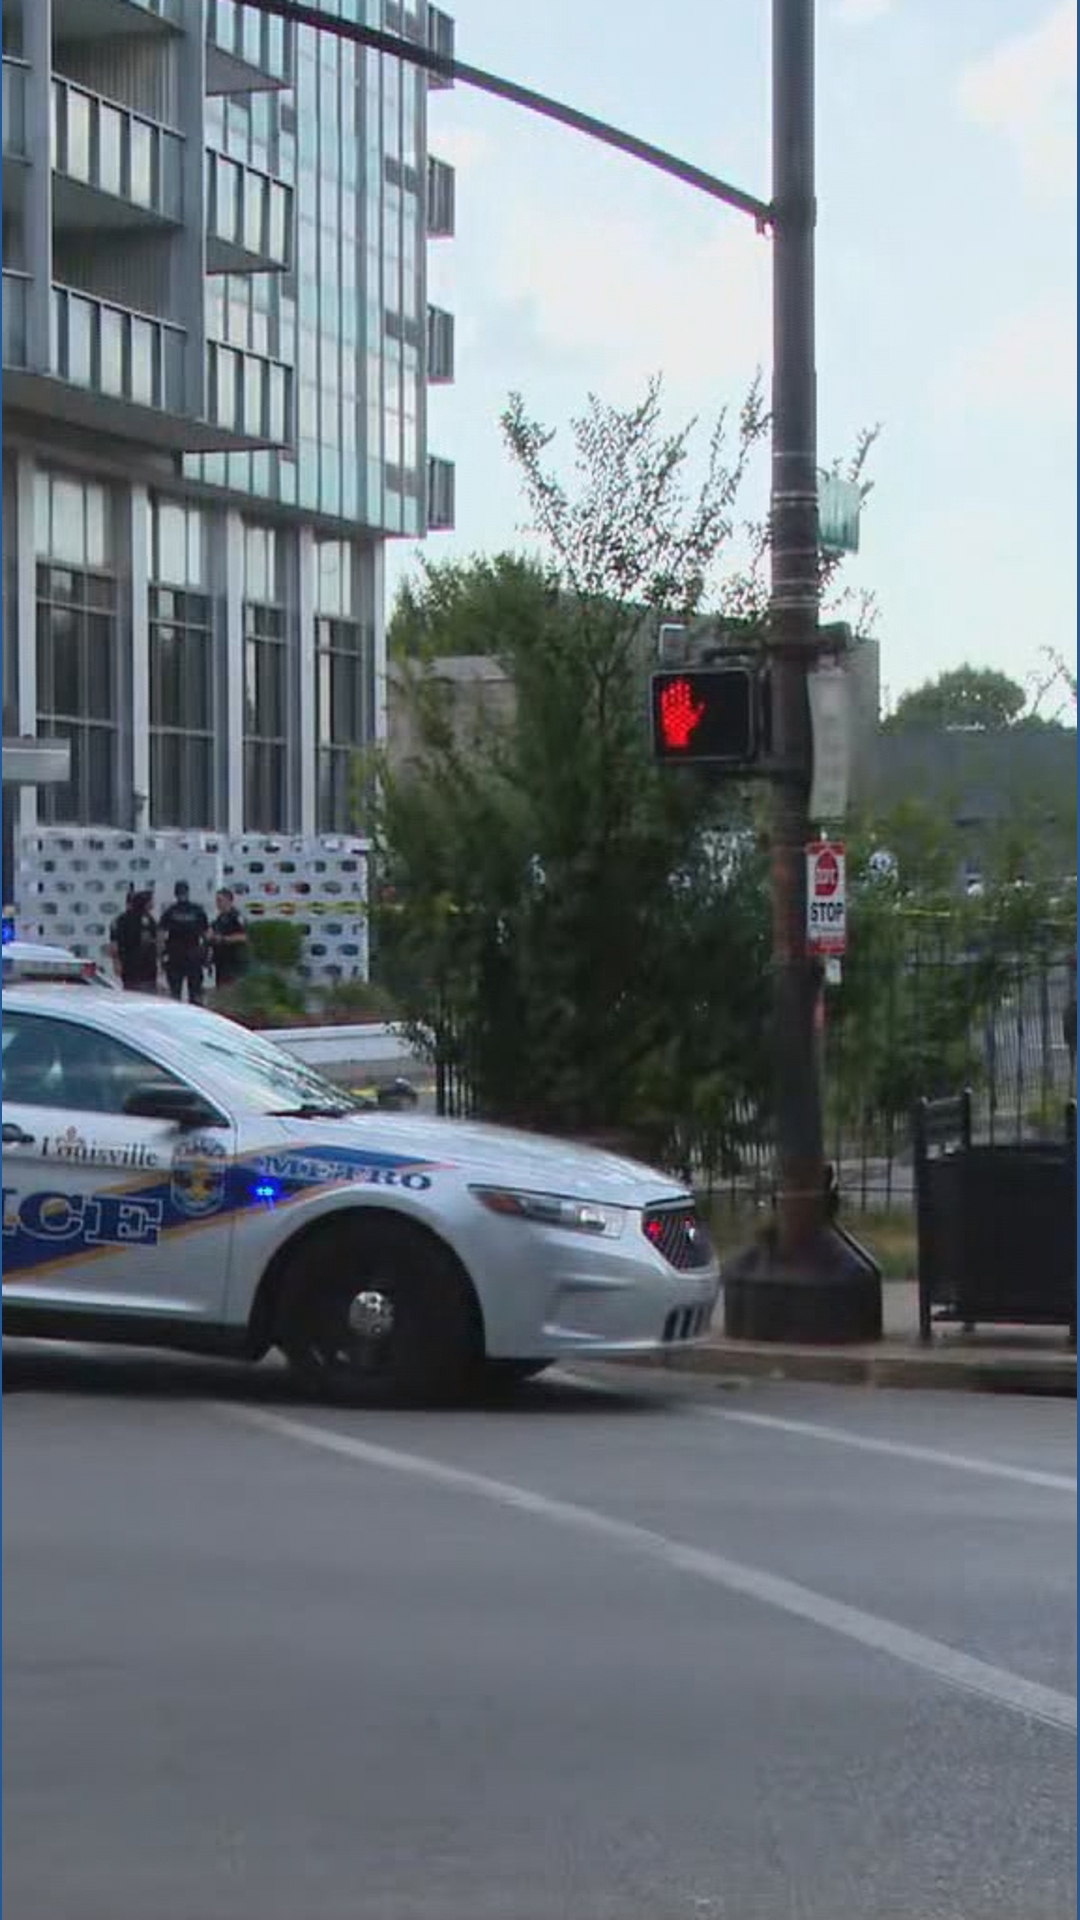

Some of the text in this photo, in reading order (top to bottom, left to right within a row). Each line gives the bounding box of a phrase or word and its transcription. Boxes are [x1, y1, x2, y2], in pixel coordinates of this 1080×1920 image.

[810, 902, 844, 921] STOP
[41, 1137, 158, 1167] Louisville
[263, 1154, 432, 1191] METRO
